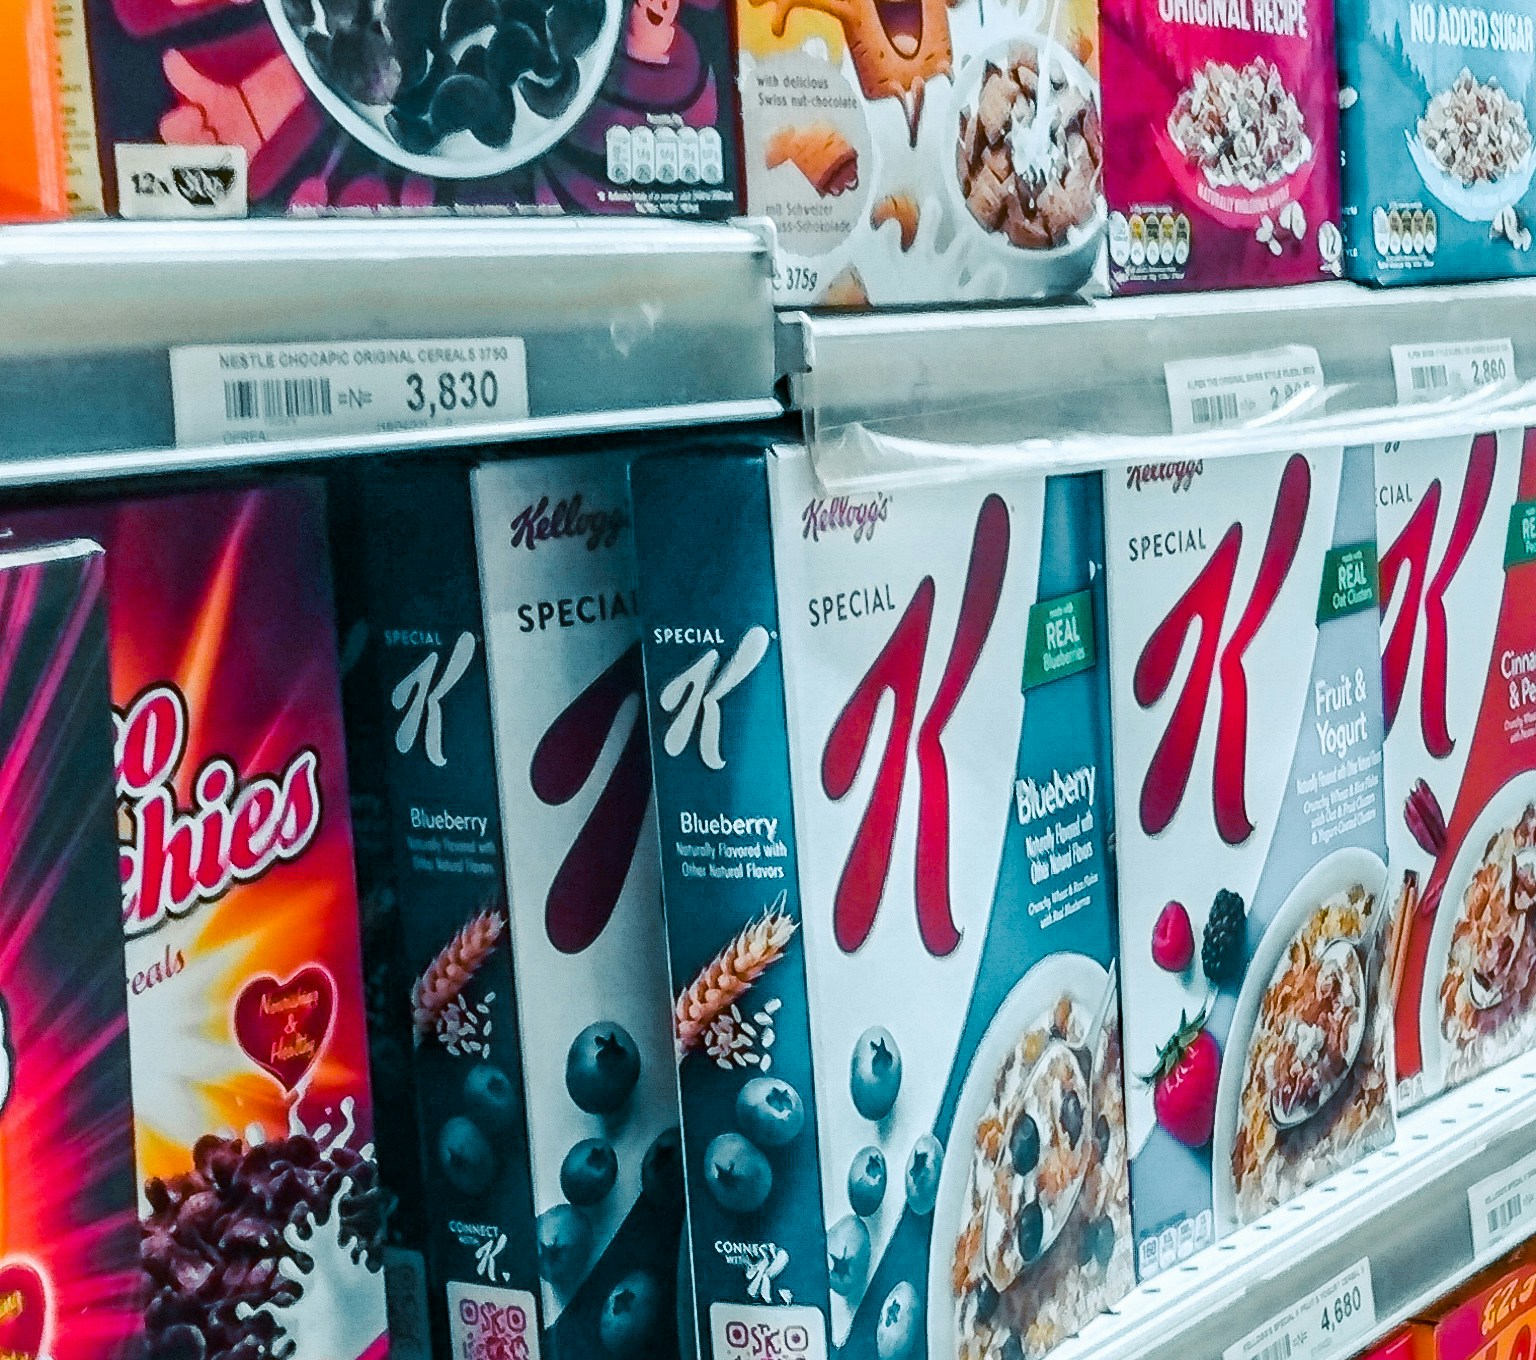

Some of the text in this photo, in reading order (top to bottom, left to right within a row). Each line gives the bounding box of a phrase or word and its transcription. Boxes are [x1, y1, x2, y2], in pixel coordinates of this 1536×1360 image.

[1409, 1, 1535, 54] NO ADDED SUGAR
[757, 74, 829, 91] with delicious
[758, 91, 858, 111] Swiss nut-chocolate
[786, 267, 819, 293] 375g
[219, 346, 478, 370] NESTLE CHOCAPIC ORIGINAL CEREALS
[405, 370, 499, 419] 3,830
[801, 492, 895, 544] Kellogg's
[1128, 528, 1207, 562] SPECIAL
[1337, 558, 1368, 593] REAL
[808, 583, 897, 627] SPECIAL
[1331, 586, 1373, 611] Oat Clusters
[653, 627, 725, 645] SPECIAL
[1045, 615, 1081, 652] REAL
[1133, 452, 1312, 847] K
[1042, 646, 1086, 675] Blueberries
[659, 624, 771, 770] K
[1315, 665, 1368, 717] Fruit &
[1508, 683, 1521, 709] &
[820, 492, 1011, 958] K
[1316, 714, 1368, 761] Yogurt
[1016, 763, 1096, 826] Blueberry
[410, 805, 489, 836] Blueberry
[680, 810, 779, 839] Blueberry
[675, 840, 789, 860] Naturally Flavored with
[681, 861, 786, 880] Other Natural Flavors
[1320, 1288, 1362, 1333] 4,680
